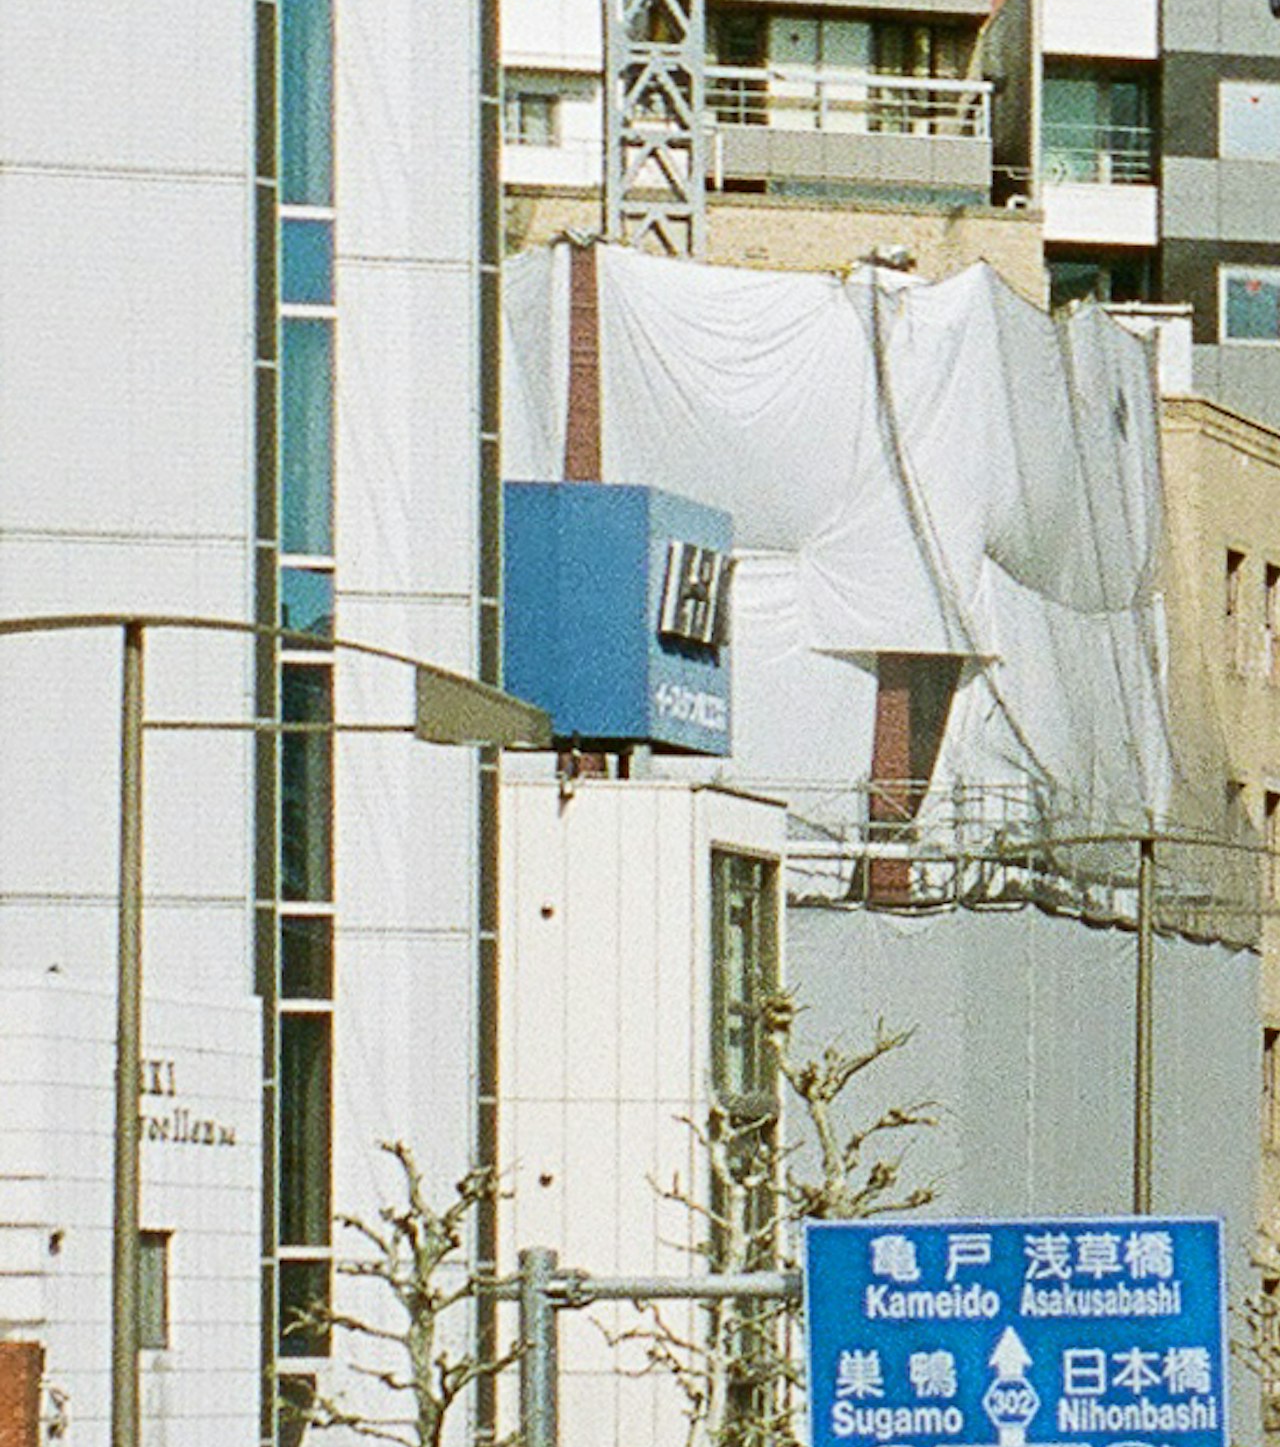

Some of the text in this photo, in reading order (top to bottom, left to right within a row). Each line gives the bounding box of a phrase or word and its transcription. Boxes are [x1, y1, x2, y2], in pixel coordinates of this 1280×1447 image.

[870, 1230, 1174, 1281] 亀戸 浅草橋
[866, 1281, 1182, 1320] Kameido Asakusabashi
[835, 1347, 1211, 1399] 巣鴨 日本橋
[832, 1397, 1219, 1438] Sugamo Nihonbashi
[990, 1389, 1032, 1416] 302
